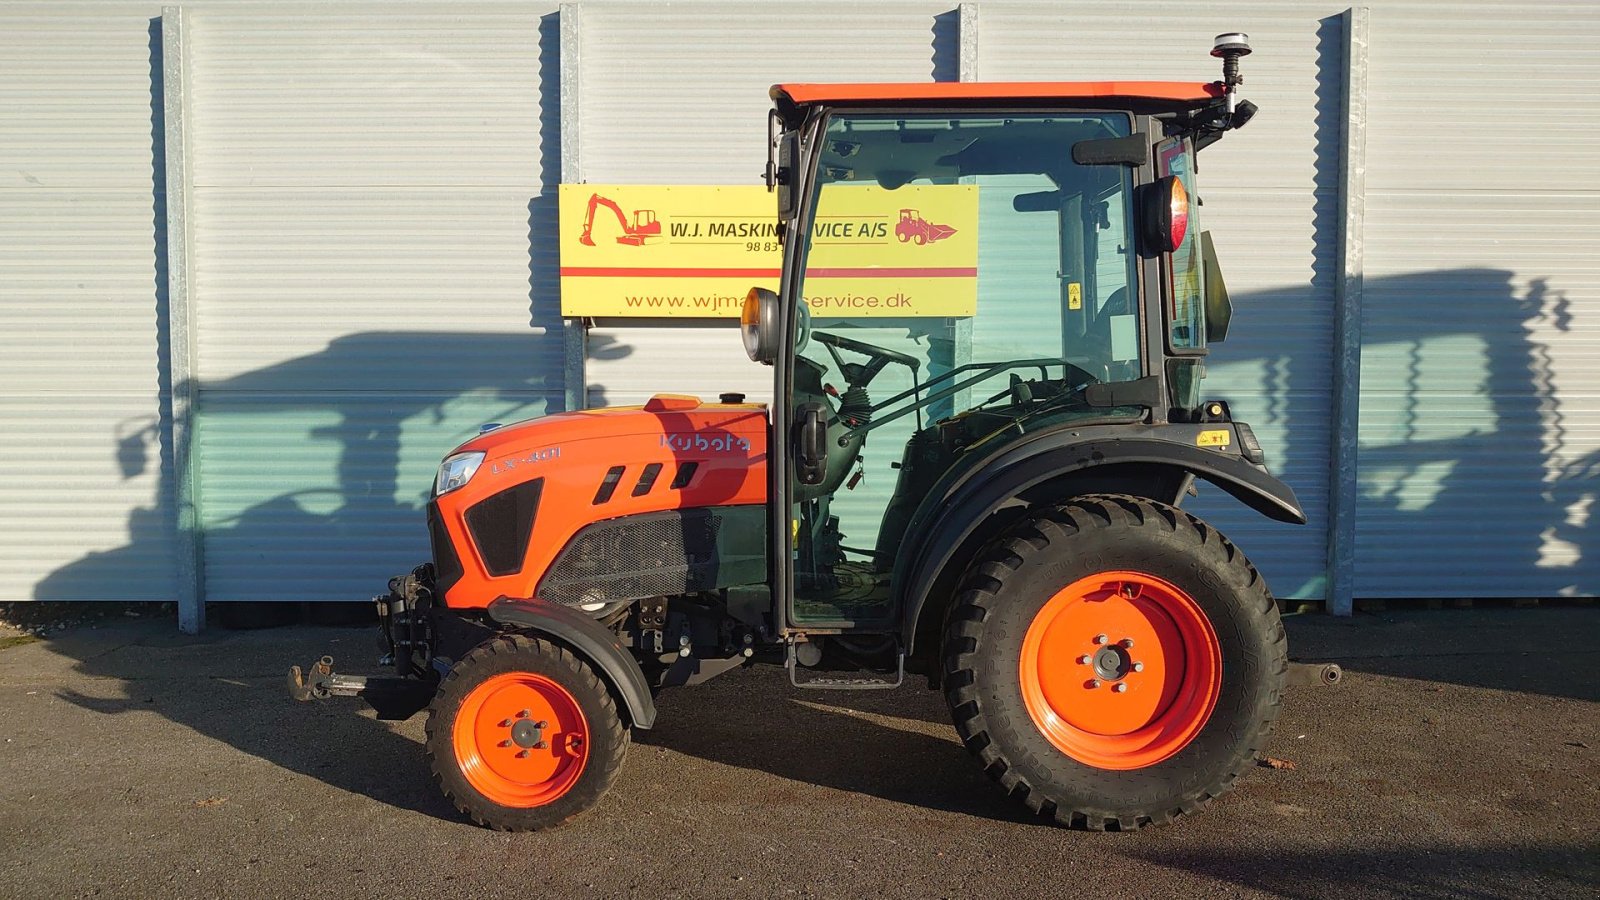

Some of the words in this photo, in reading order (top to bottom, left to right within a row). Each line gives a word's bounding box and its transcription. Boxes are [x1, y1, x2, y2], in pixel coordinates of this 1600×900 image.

[670, 222, 703, 238] W.J.
[708, 222, 855, 238] MASKINVICE
[858, 222, 888, 239] A/S
[746, 241, 761, 252] 98
[764, 241, 778, 252] 83
[625, 293, 913, 312] www.wjmervice.dk
[660, 432, 751, 452] Kubota
